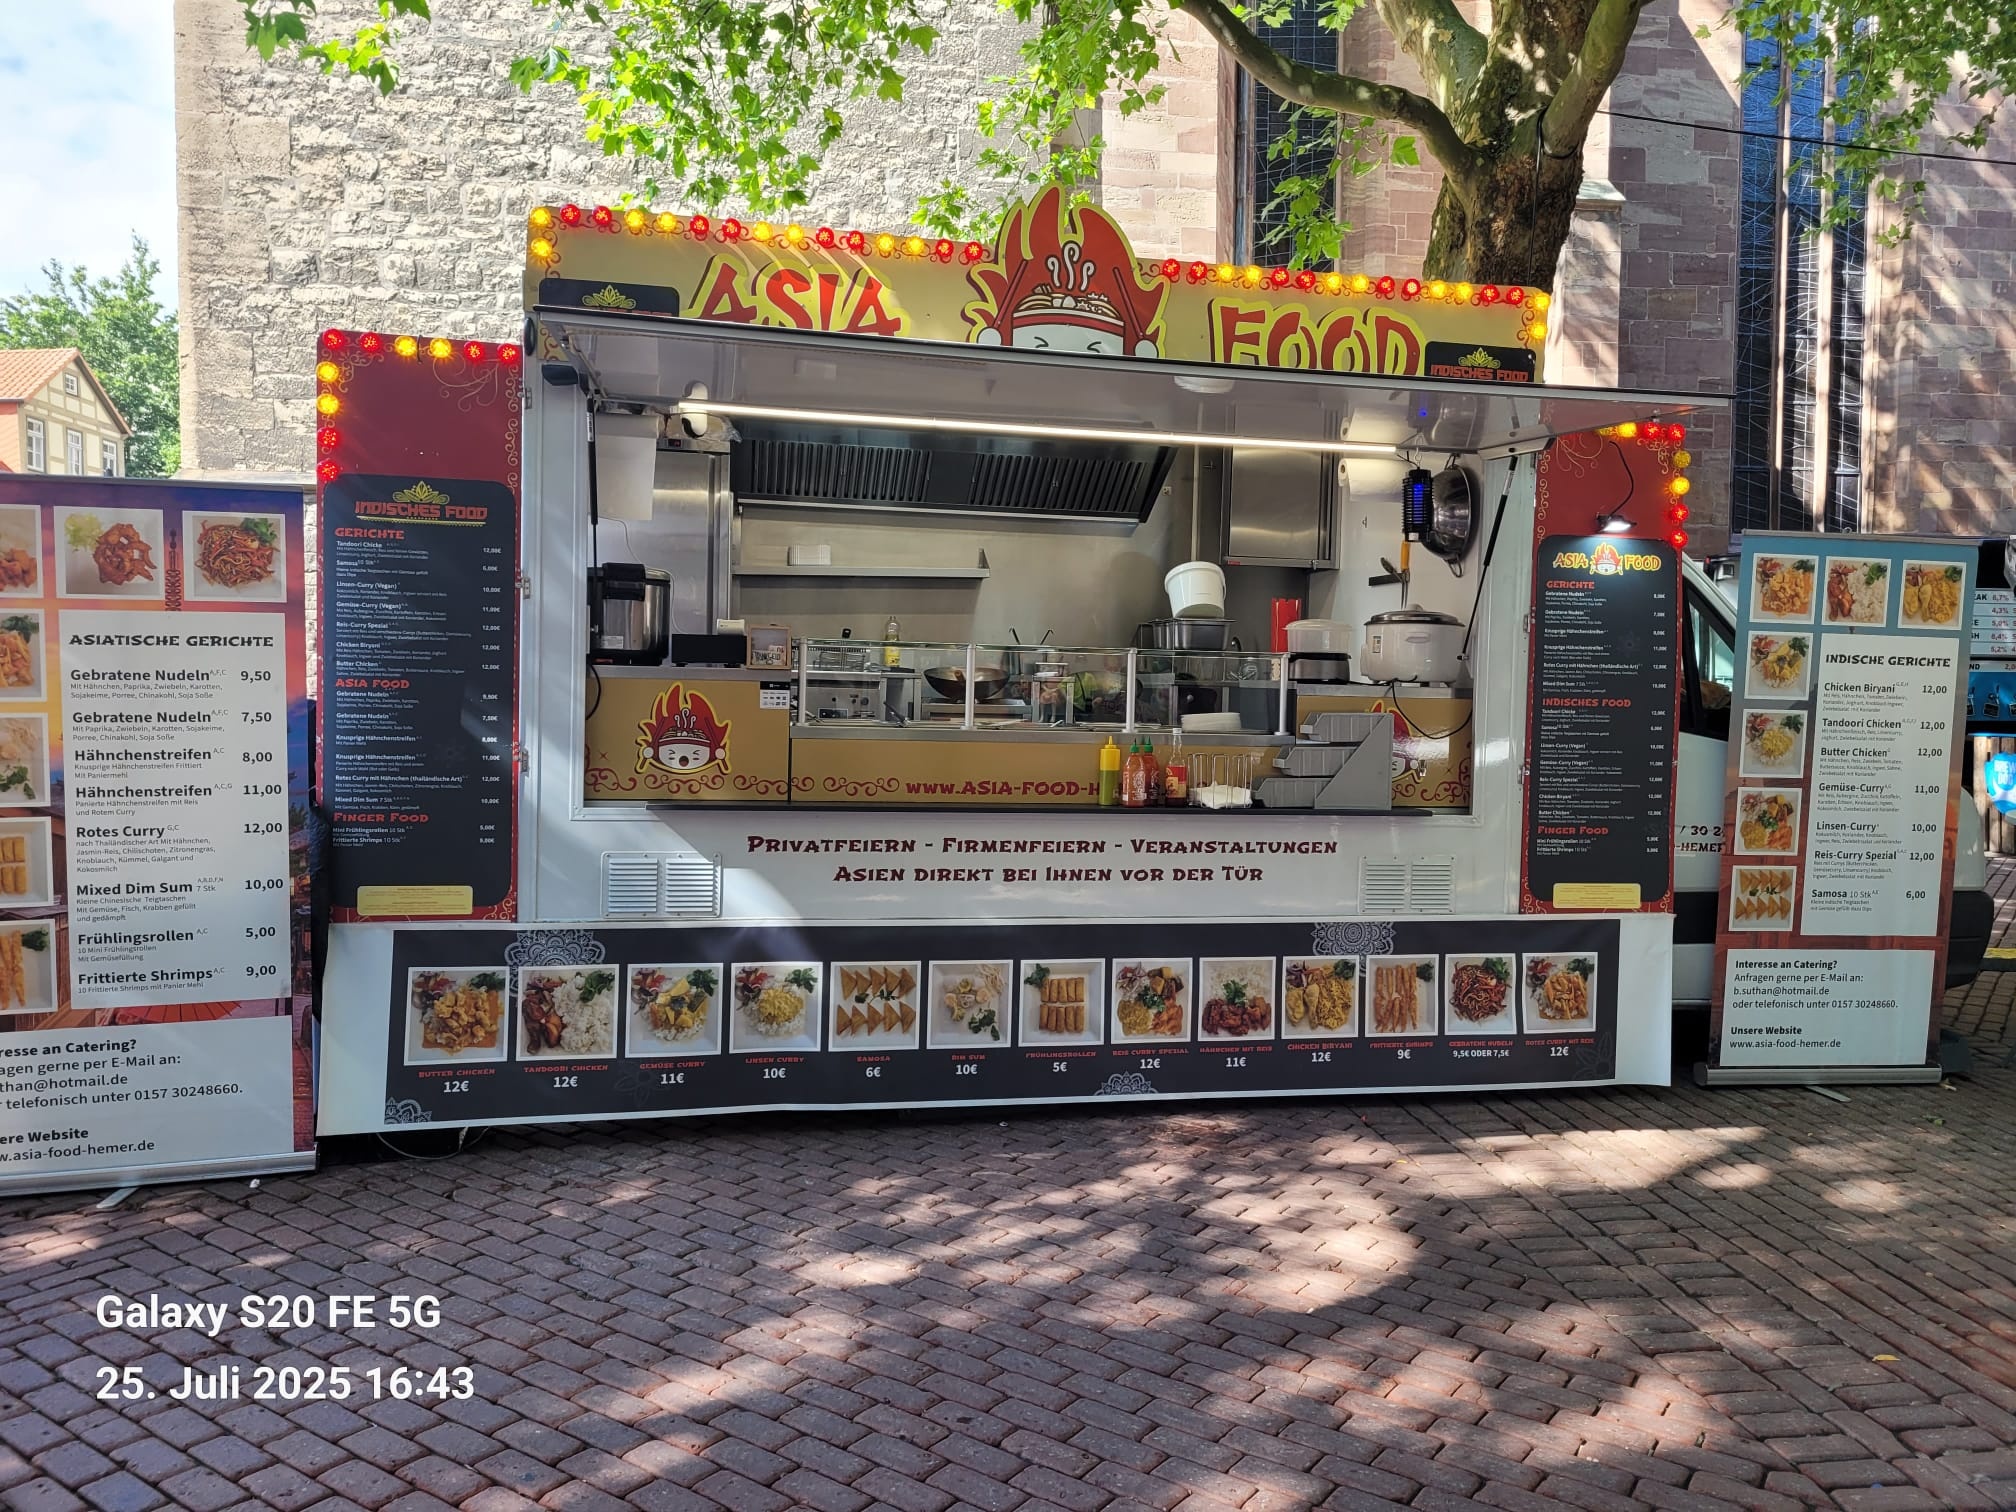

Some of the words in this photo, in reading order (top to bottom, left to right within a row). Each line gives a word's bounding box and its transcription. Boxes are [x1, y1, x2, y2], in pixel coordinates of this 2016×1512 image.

[697, 258, 905, 336] ASIA
[1210, 299, 1425, 376] FOOD
[354, 501, 441, 518] INDISCHES
[445, 505, 489, 520] FOOD
[335, 527, 405, 540] GERICHTE
[1553, 552, 1589, 569] ASIA
[1624, 554, 1662, 571] FOOD
[1546, 580, 1595, 590] GERICHTE
[69, 635, 180, 647] ASIATISCHE
[186, 636, 274, 649] GERICHTE
[1825, 654, 1885, 666] INDISCHE
[1888, 656, 1951, 668] GERICHTE
[70, 669, 151, 682] Gebratene
[155, 669, 210, 682] Nudeln
[240, 671, 272, 683] 9,50
[336, 678, 368, 688] ASIA
[372, 679, 410, 689] FOOD
[1824, 682, 1861, 693] Chicken
[1864, 683, 1896, 695] Biryani
[1922, 685, 1948, 696] 12,00
[1542, 698, 1599, 708] INDISCHES
[1602, 698, 1632, 708] FOOD
[72, 711, 152, 724] Gebratene
[157, 711, 211, 724] Nudeln
[241, 711, 273, 724] 7,50
[1822, 718, 1864, 728] Tandoori
[1866, 718, 1902, 730] Chicken
[1920, 721, 1946, 732] 12,00
[74, 749, 212, 761] Hähnchenstreifen
[242, 752, 273, 765] 8,00
[1821, 748, 1851, 758] Butter
[1852, 748, 1888, 759] Chicken
[1917, 748, 1943, 759] 12,00
[76, 786, 213, 798] Hähnchenstreifen
[243, 784, 283, 798] 11,00
[1819, 783, 1885, 795] Gemüse-Curry
[1914, 785, 1940, 796] 11,00
[334, 812, 385, 823] FINGER
[390, 812, 430, 823] FOOD
[76, 826, 119, 838] Rotes
[122, 826, 166, 840] Curry
[243, 823, 283, 837] 12,00
[1537, 826, 1576, 835] FINGER
[1580, 826, 1609, 836] FOOD
[1816, 821, 1876, 833] Linsen-Curry
[1911, 823, 1937, 834] 10,00
[746, 835, 916, 855] PRIVATFEIERN
[941, 836, 1106, 855] FIRMENFEIERN
[1130, 838, 1339, 856] VERANSTALTUNGEN
[1814, 851, 1863, 863] Reis-Curry
[1865, 851, 1897, 863] Spezial
[1909, 852, 1935, 864] 12,00
[832, 865, 906, 883] ASIEN
[914, 866, 995, 883] DIREKT
[1002, 867, 1038, 883] BEI
[1045, 866, 1113, 883] IHNEN
[1120, 867, 1165, 883] VOR
[1173, 867, 1215, 883] DER
[1221, 864, 1264, 884] TÜR
[76, 883, 121, 896] Mixed
[125, 883, 156, 895] Dim
[159, 882, 193, 894] Sum
[244, 879, 284, 892] 10,00
[1811, 889, 1848, 900] Samosa
[1905, 890, 1926, 901] 6,00
[78, 930, 194, 947] Frühlingsrollen
[245, 927, 276, 941] 5,00
[1735, 960, 1778, 969] Interesse
[1780, 961, 1791, 969] an
[1793, 960, 1838, 971] Catering?
[78, 972, 147, 985] Frittierte
[151, 969, 213, 984] Shrimps
[246, 965, 277, 979] 9,00
[1734, 973, 1774, 984] Anfragen
[1776, 975, 1802, 985] gerne
[1803, 975, 1819, 985] per
[1820, 973, 1848, 982] E-Mail
[1849, 974, 1864, 982] an:
[1733, 986, 1830, 997] b.suthan@hotmail.de
[1732, 1000, 1753, 1009] oder
[1754, 999, 1804, 1009] telefonisch
[1806, 1000, 1830, 1009] unter
[1831, 999, 1853, 1009] 0157
[1854, 999, 1899, 1009] 30248660.
[1730, 1026, 1764, 1036] Unsere
[1765, 1026, 1803, 1036] Website
[42, 1046, 62, 1056] an
[66, 1039, 137, 1055] Catering?
[1729, 1039, 1842, 1049] www.asia-food-hemer.de
[1311, 1051, 1332, 1063] 12€
[1397, 1049, 1411, 1060] 9€
[1452, 1049, 1470, 1060] 9,5€
[1471, 1049, 1492, 1058] ODER
[1493, 1049, 1510, 1059] 7,5€
[1550, 1046, 1569, 1057] 12€
[37, 1061, 80, 1076] gerne
[83, 1060, 108, 1073] per
[111, 1055, 155, 1068] E-Mail
[159, 1055, 181, 1066] an:
[1052, 1062, 1068, 1073] 5€
[1139, 1058, 1161, 1070] 12€
[1225, 1057, 1247, 1069] 11€
[763, 1067, 787, 1079] 10€
[865, 1067, 882, 1078] 6€
[955, 1064, 979, 1076] 10€
[553, 1076, 579, 1088] 12€
[660, 1072, 685, 1085] 11€
[443, 1080, 470, 1093] 12€
[6, 1095, 88, 1111] telefonisch
[92, 1092, 131, 1104] unter
[134, 1088, 168, 1101] 0157
[171, 1084, 243, 1099] 30248660.
[27, 1127, 89, 1143] Website
